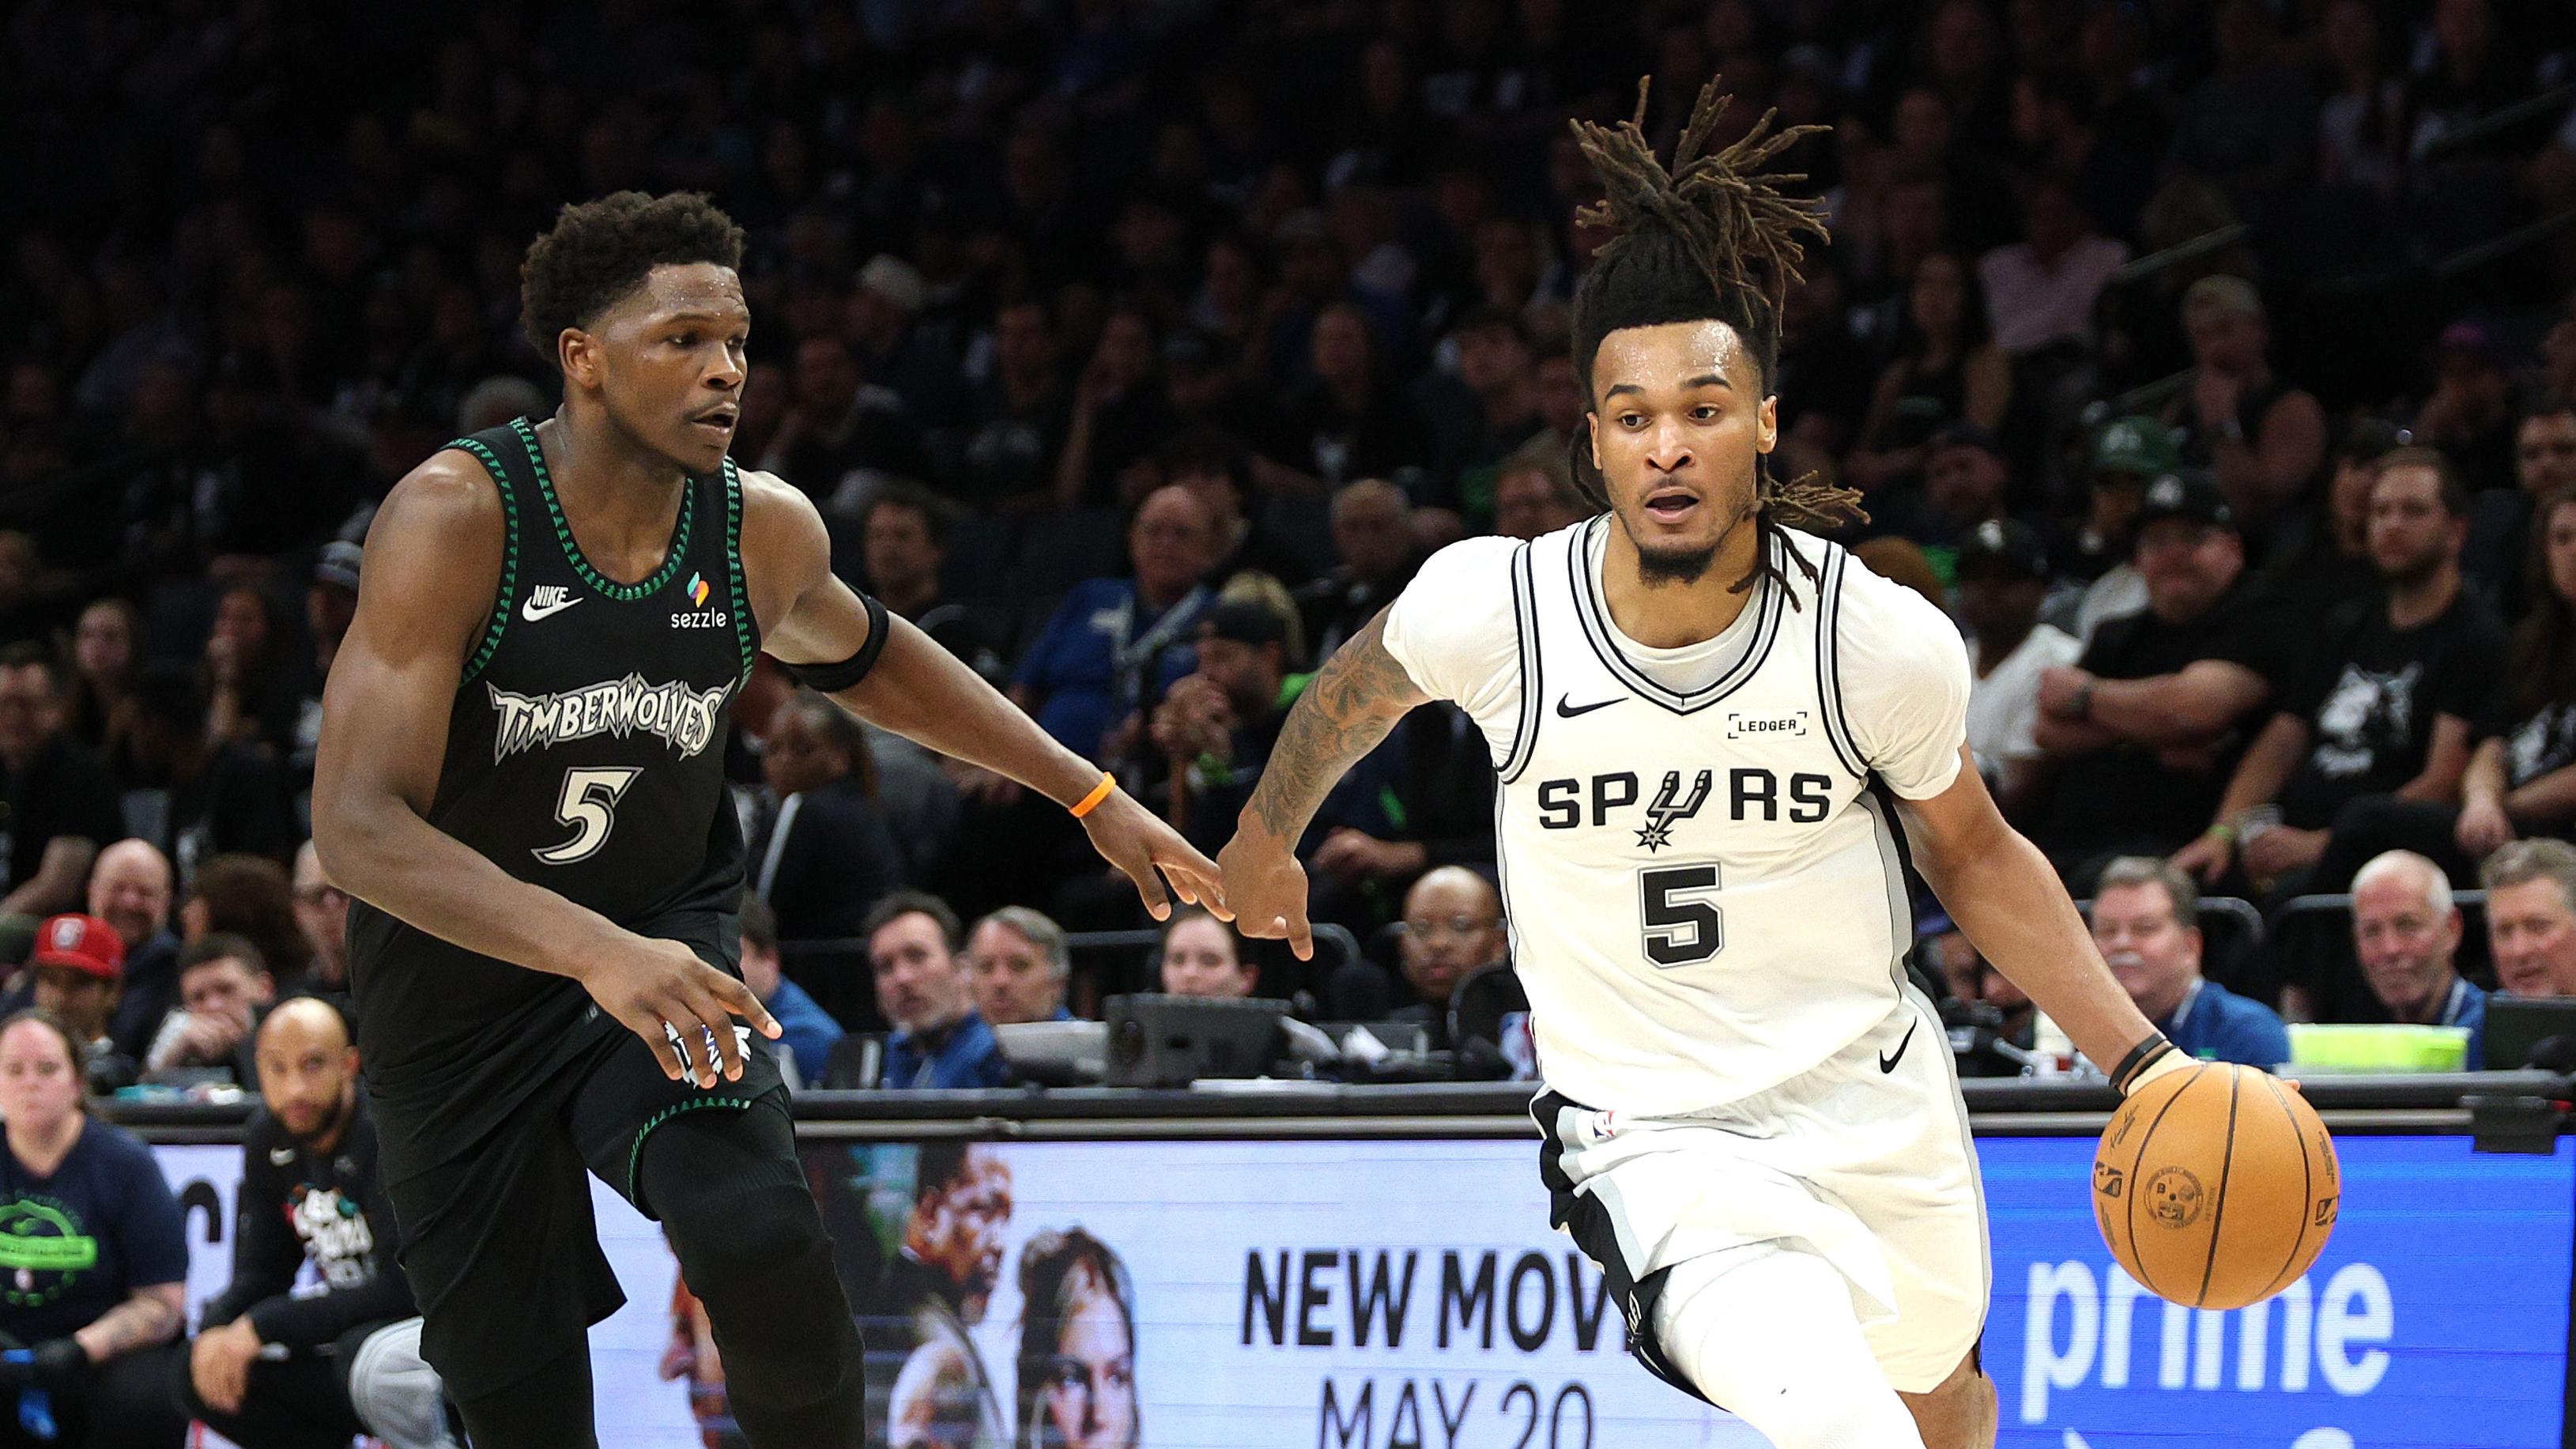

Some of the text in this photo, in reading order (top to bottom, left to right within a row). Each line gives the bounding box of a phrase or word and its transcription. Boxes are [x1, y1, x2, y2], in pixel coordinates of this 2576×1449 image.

[531, 584, 569, 607] NIKE
[670, 606, 726, 628] sezzle
[1737, 718, 1798, 734] LEDGER
[530, 765, 644, 866] 5
[1537, 768, 1833, 854] SPURS
[1637, 861, 1725, 969] 5
[1242, 1249, 1633, 1352] NEW MOV
[1318, 1379, 1595, 1449] MAY 20
